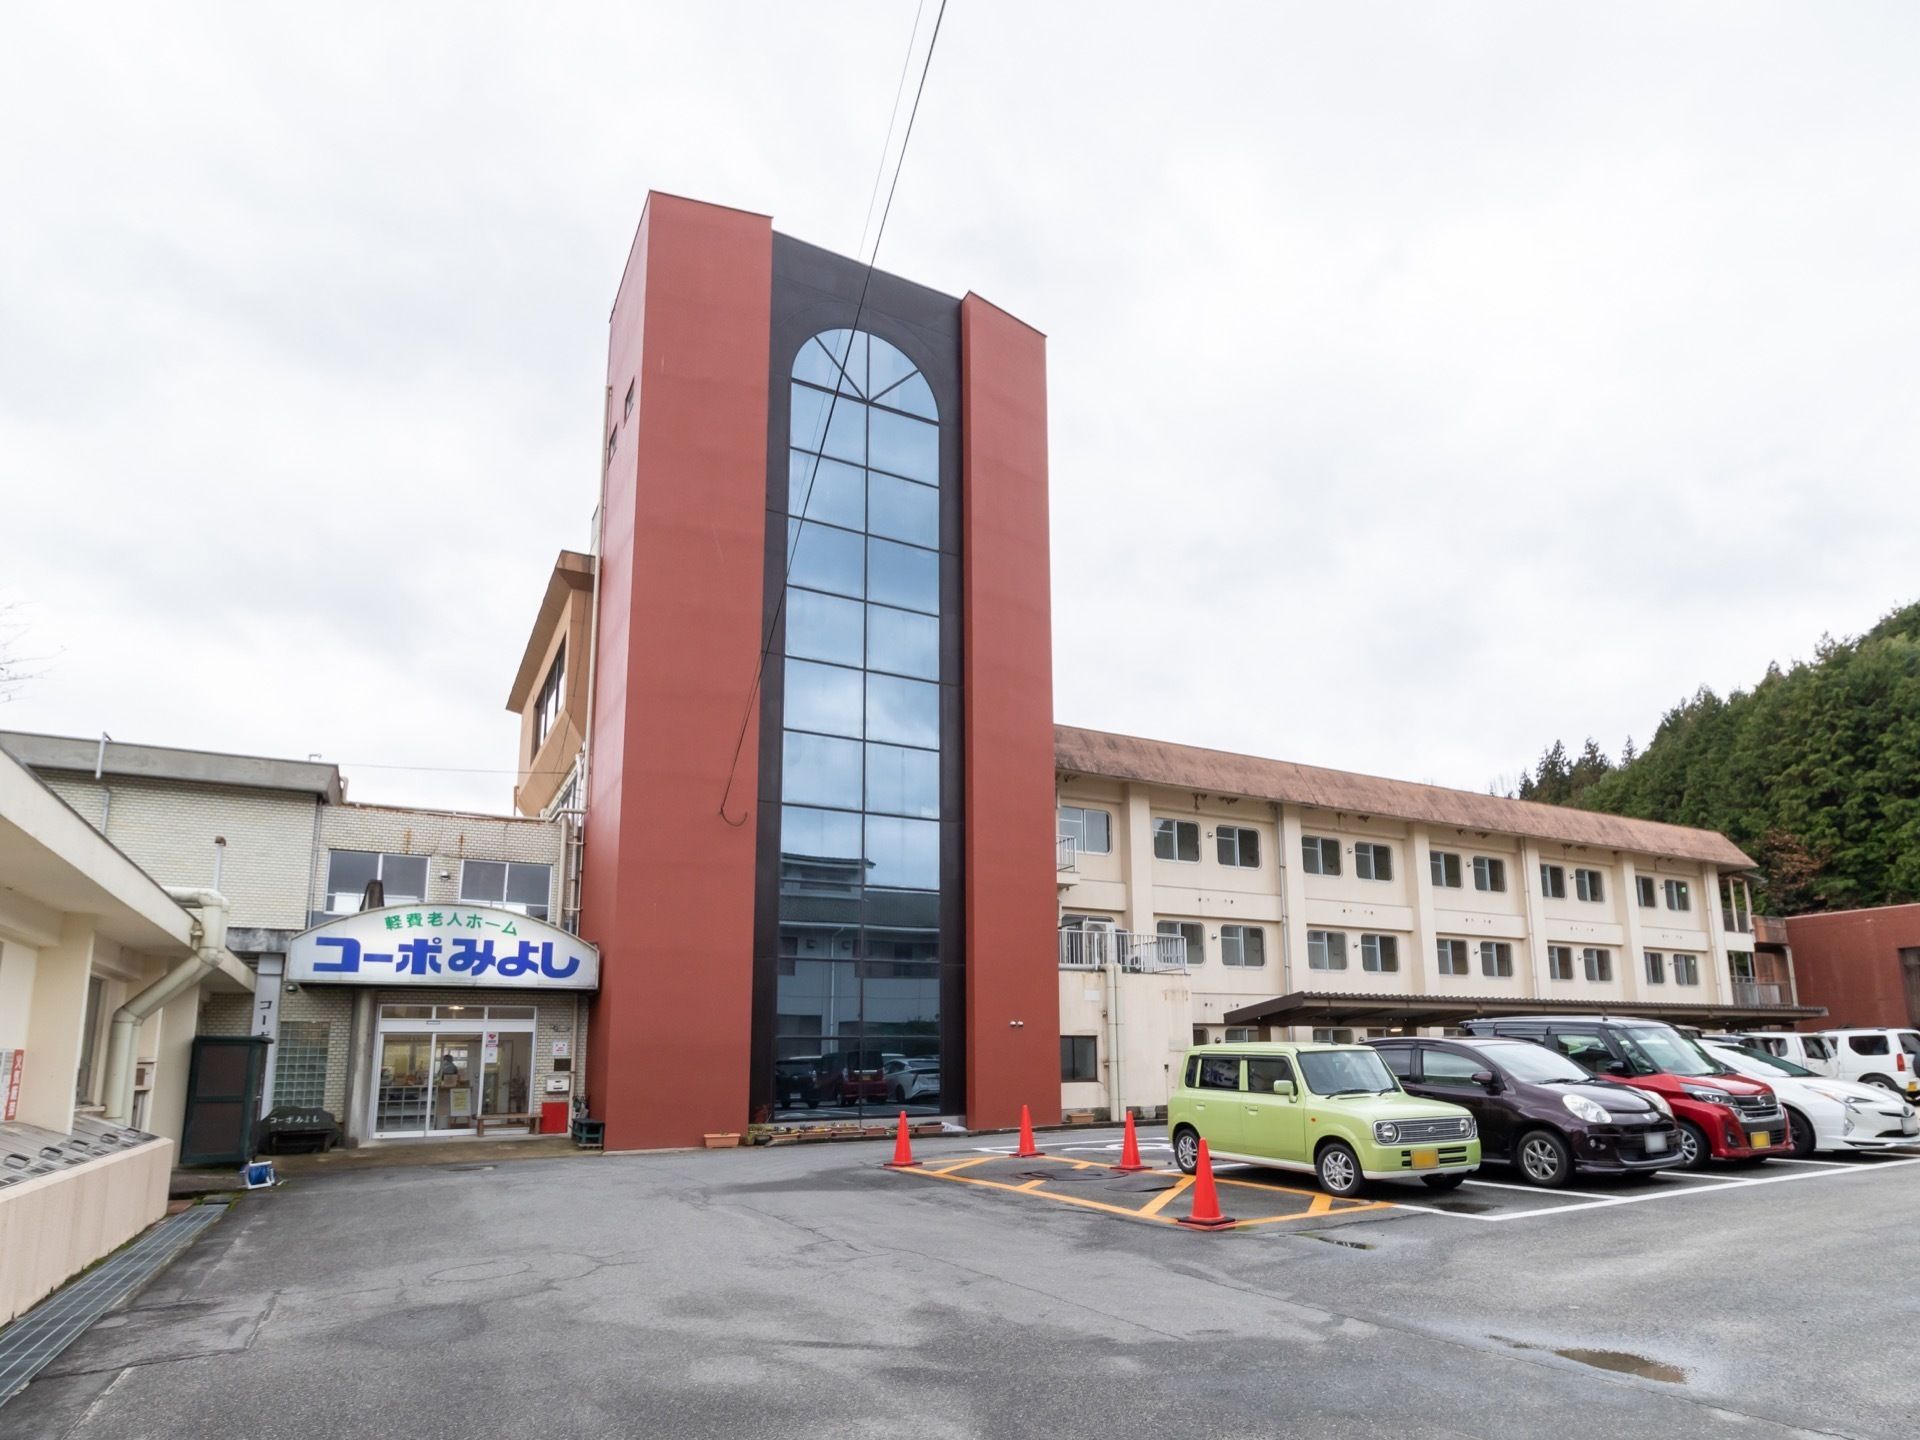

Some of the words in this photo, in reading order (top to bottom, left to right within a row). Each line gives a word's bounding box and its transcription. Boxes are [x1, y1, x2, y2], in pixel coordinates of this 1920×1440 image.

[384, 912, 517, 936] 軽費老人ホーム
[313, 937, 580, 978] コーポみよし
